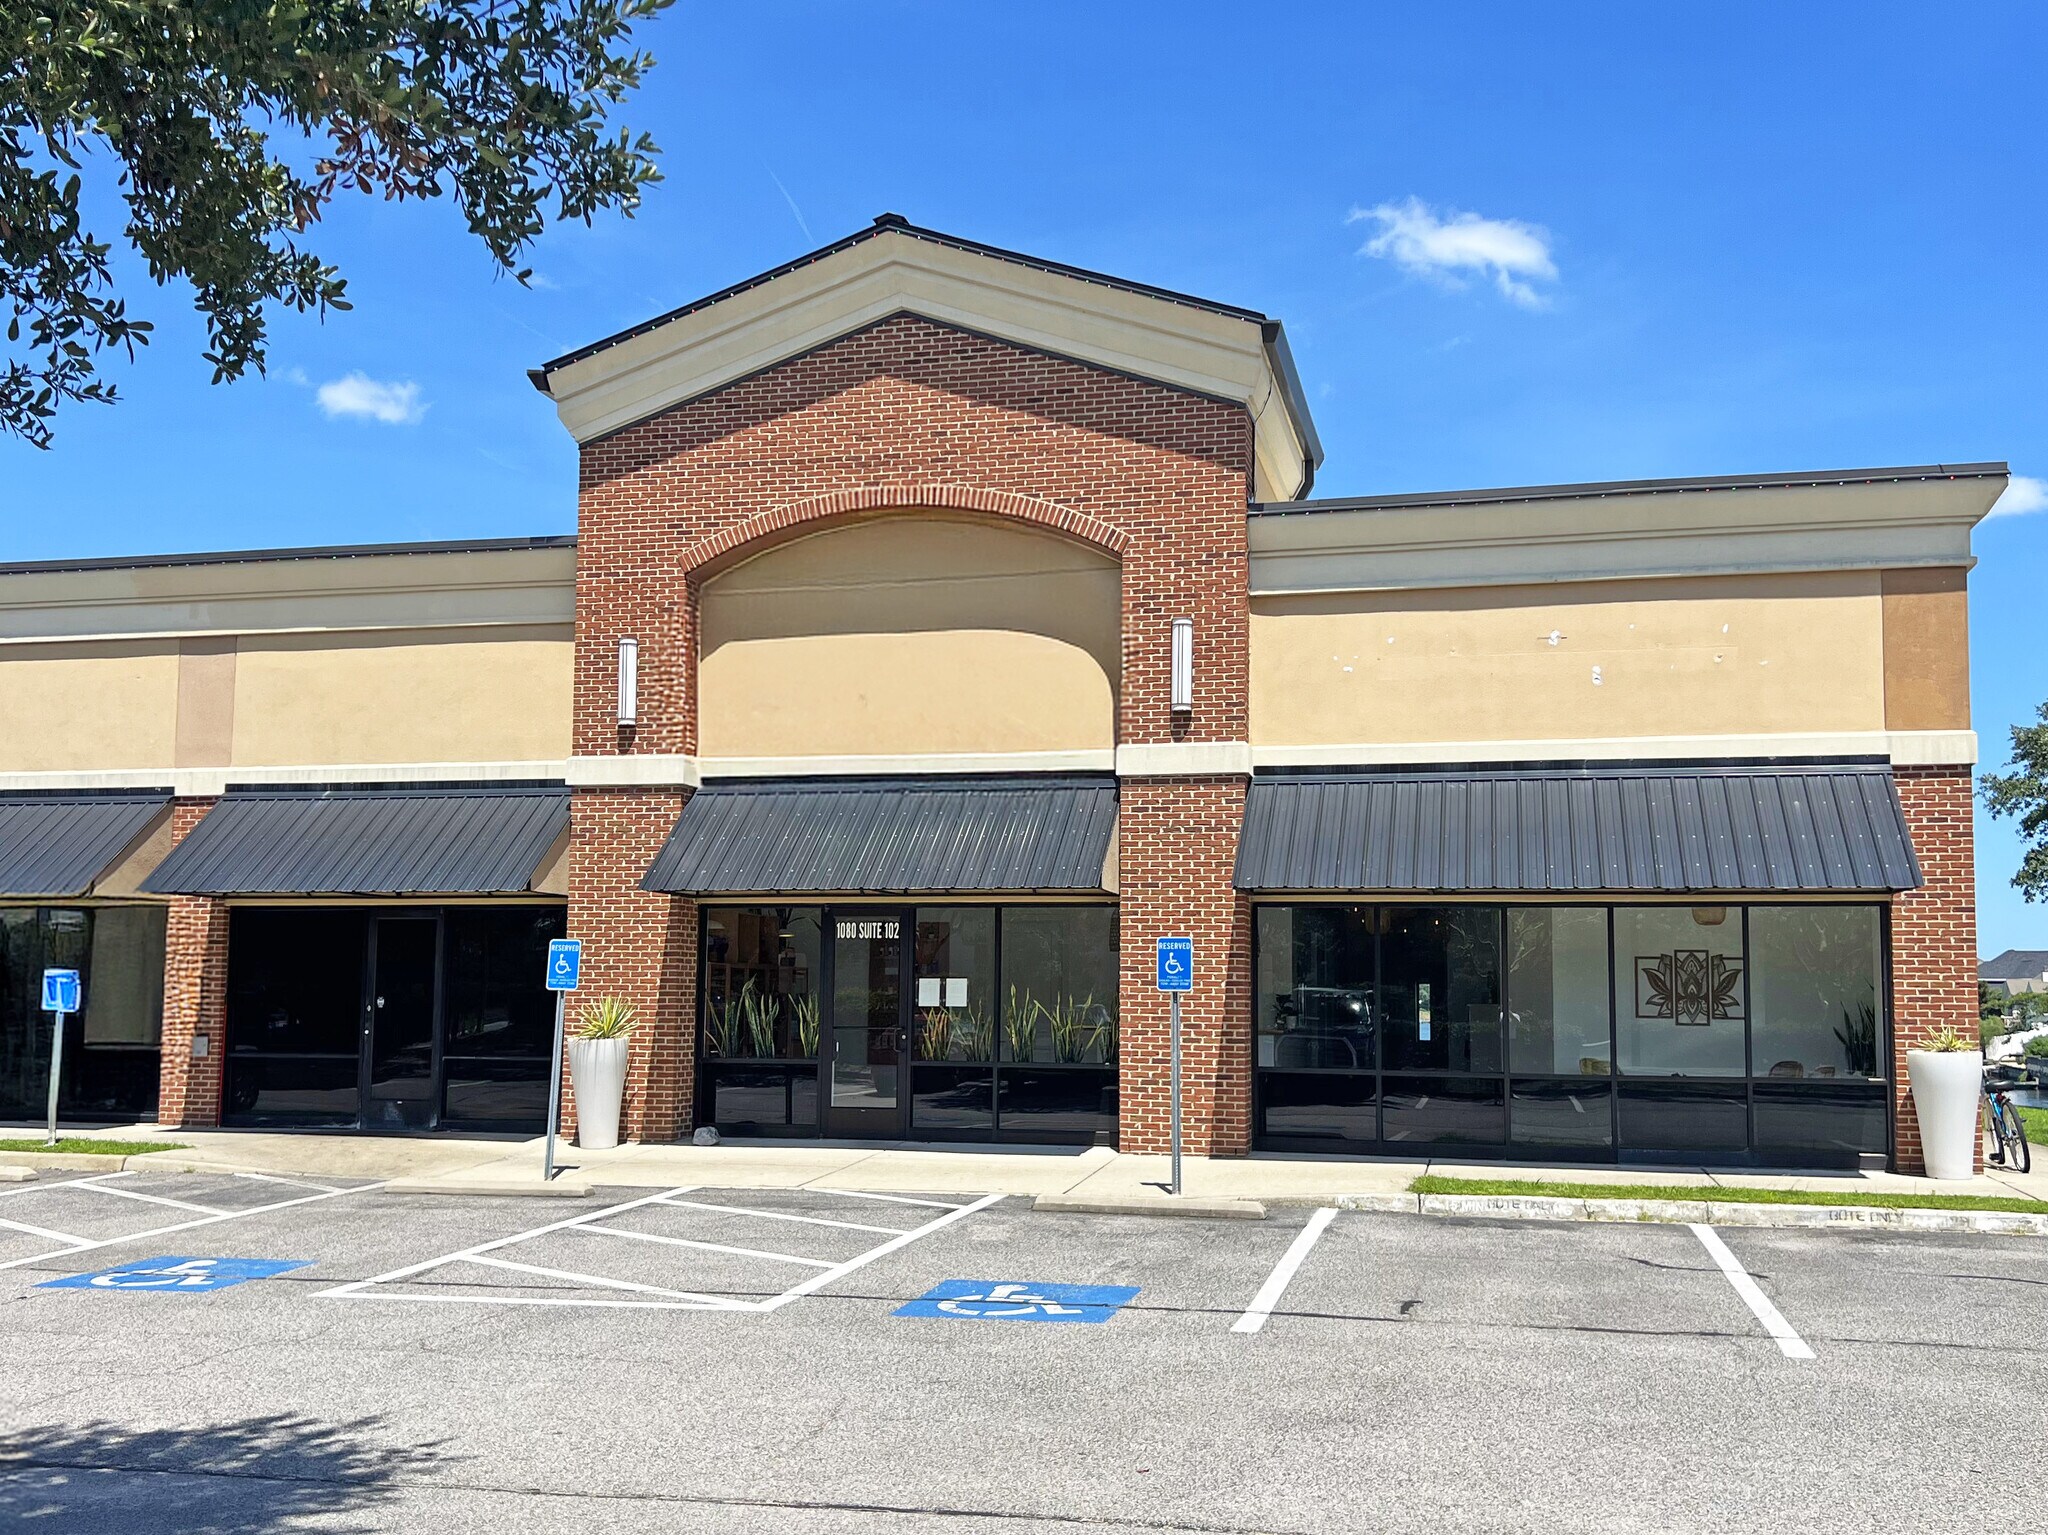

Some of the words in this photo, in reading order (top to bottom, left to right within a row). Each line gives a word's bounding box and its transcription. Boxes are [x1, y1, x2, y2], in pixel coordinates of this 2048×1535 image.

[836, 922, 857, 939] 1080
[859, 922, 882, 939] SUITE
[884, 922, 900, 939] 102
[551, 944, 579, 952] RESERVED
[1158, 942, 1191, 950] RESERVED
